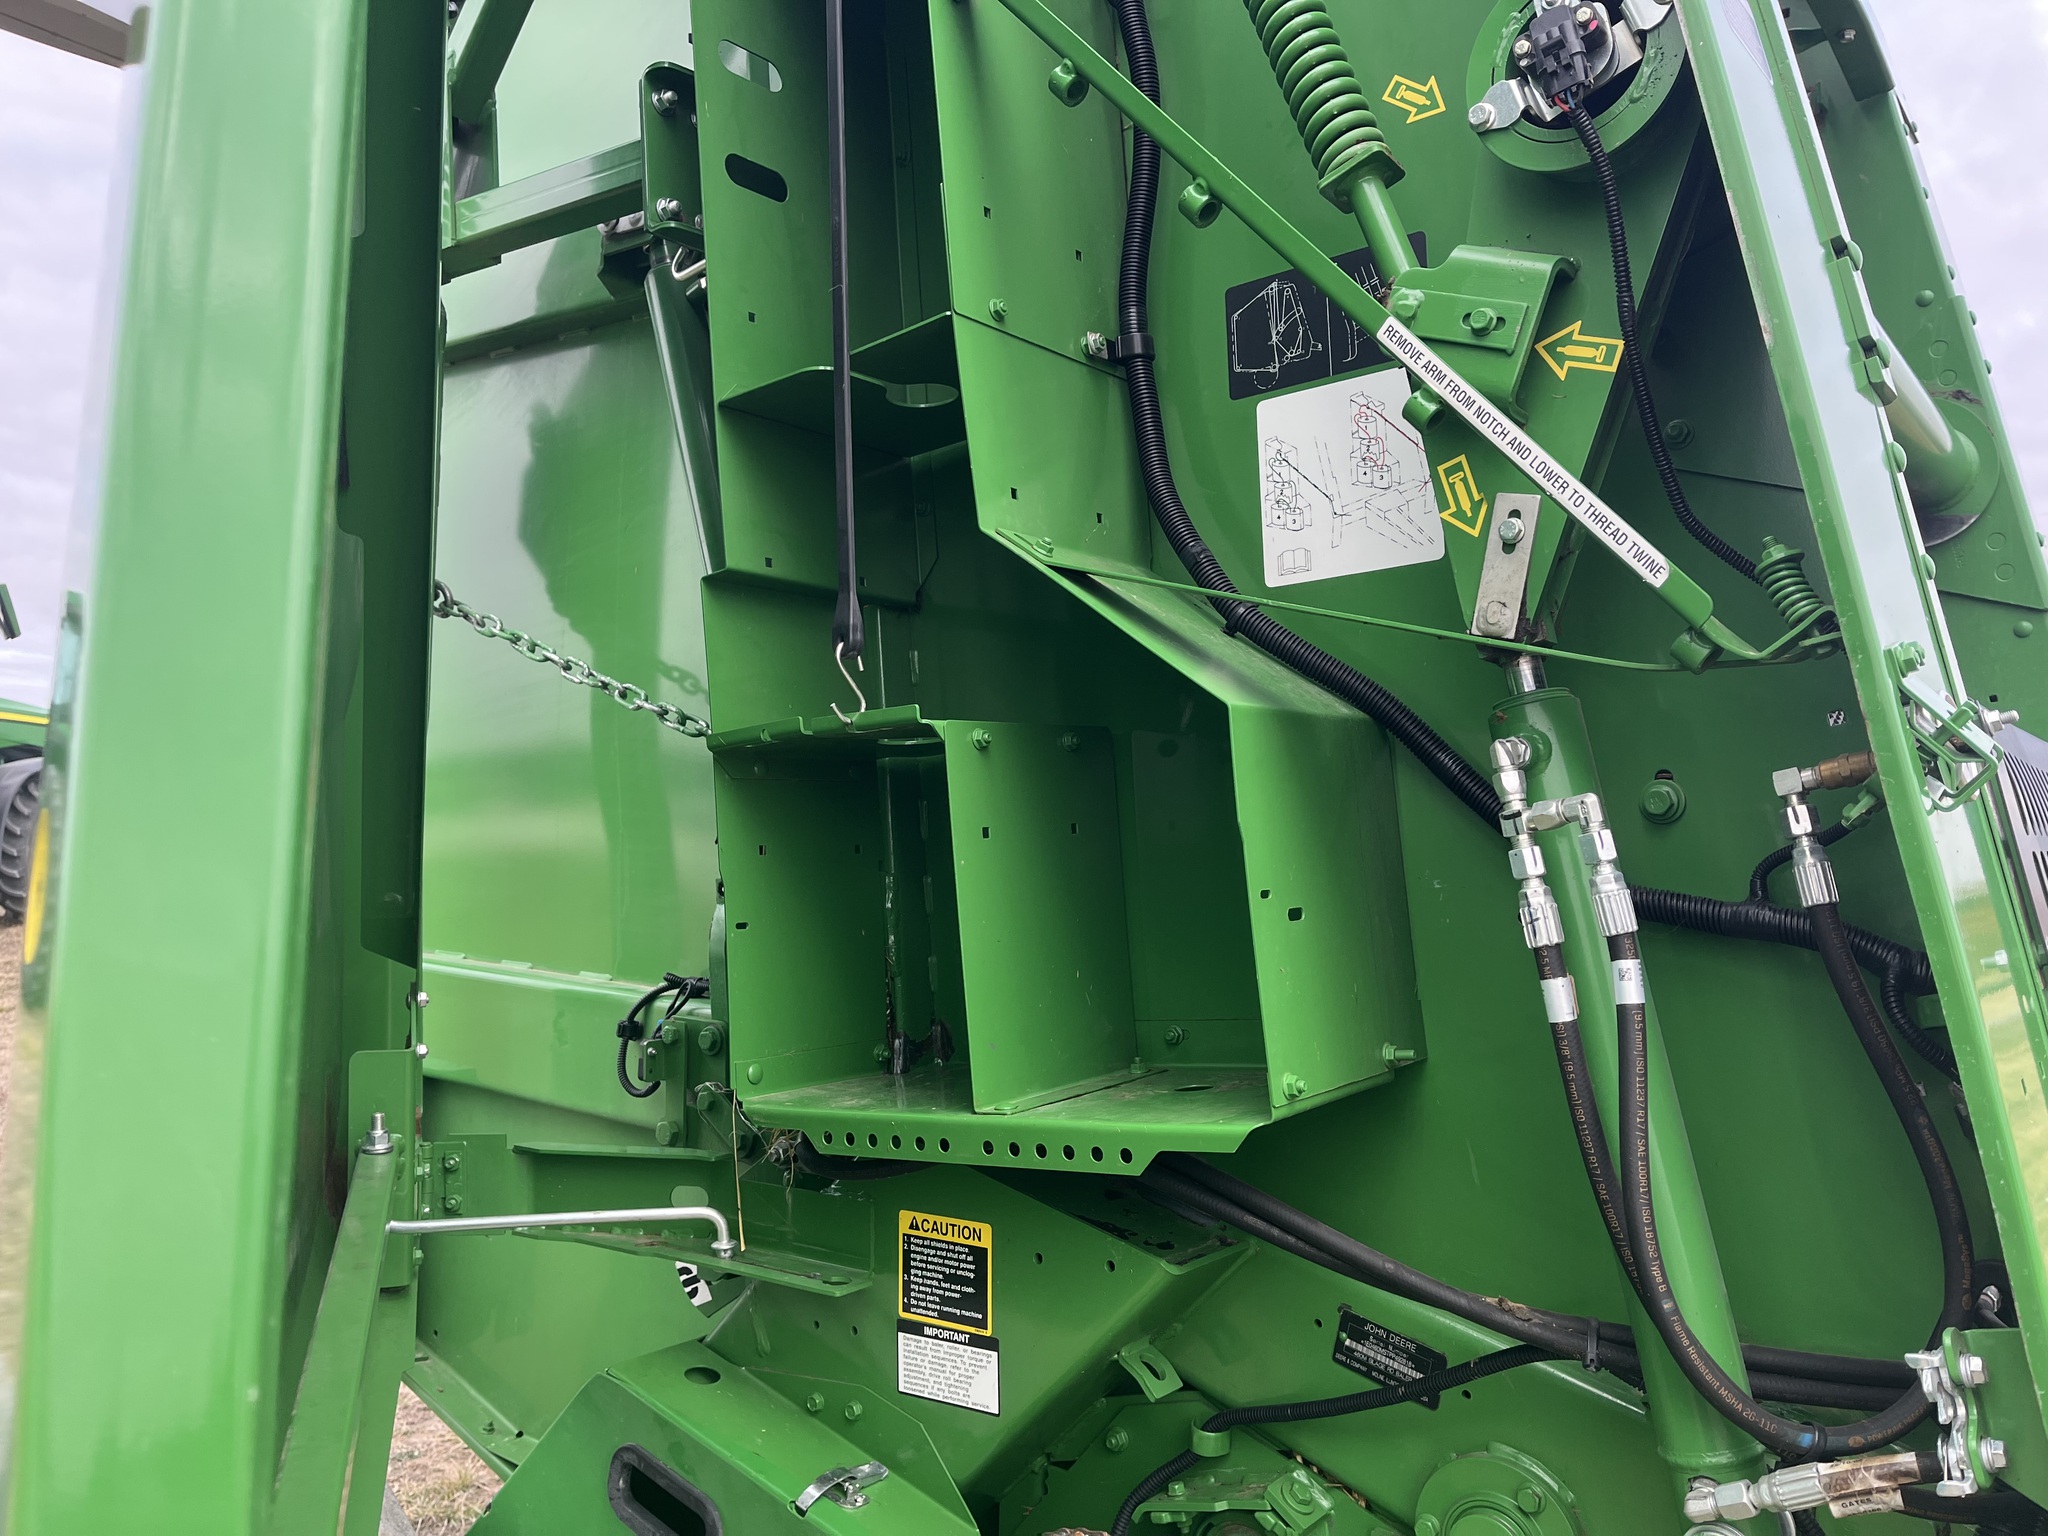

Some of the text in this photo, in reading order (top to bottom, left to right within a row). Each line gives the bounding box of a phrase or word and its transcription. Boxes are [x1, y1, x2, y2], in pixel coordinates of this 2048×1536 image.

[1383, 324, 1666, 579] REMOVE ARM FROM NOTCH AND LOWER TO THREAD TWINE
[1633, 1031, 1645, 1055] mm)
[1636, 1057, 1645, 1074] ISO
[1636, 1076, 1645, 1108] 11237
[1573, 1106, 1586, 1122] ISO
[1636, 1110, 1646, 1129] R17
[1579, 1124, 1595, 1154] 11237
[1637, 1139, 1647, 1158] SAE
[1587, 1156, 1601, 1174] R17
[1596, 1183, 1609, 1201] SAE
[1603, 1203, 1624, 1238] 100R17
[1641, 1206, 1652, 1223] ISO
[921, 1218, 982, 1243] CAUTION
[910, 1236, 923, 1246] Keep
[931, 1240, 949, 1250] shields
[955, 1244, 971, 1253] place.
[1644, 1226, 1659, 1259] 18752
[910, 1244, 936, 1256] Disengage
[937, 1249, 947, 1257] and
[947, 1250, 959, 1259] shut
[959, 1252, 967, 1260] off
[910, 1252, 976, 1270] engine and/or motor power
[1620, 1247, 1634, 1264] ISO
[910, 1260, 926, 1269] before
[927, 1263, 949, 1274] servicing
[956, 1269, 976, 1279] unclog-
[910, 1268, 944, 1280] ging machine.
[1650, 1259, 1664, 1283] Type
[910, 1275, 923, 1284] Keep
[924, 1277, 940, 1287] hands,
[940, 1281, 950, 1289] feet
[961, 1285, 976, 1294] cloth-
[910, 1283, 962, 1299] ing away from power-
[1658, 1285, 1668, 1293] B
[910, 1291, 941, 1303] driven parts.
[910, 1298, 918, 1306] Do
[927, 1301, 940, 1310] leave
[940, 1305, 960, 1316] running
[961, 1309, 983, 1320] machine
[910, 1307, 940, 1318] unattended.
[923, 1325, 970, 1344] IMPORTANT
[1364, 1322, 1417, 1353] JOHN DEERE
[1671, 1315, 1690, 1347] Flame
[902, 1335, 922, 1344] Damage
[970, 1348, 993, 1359] bearings
[903, 1353, 918, 1362] failure
[943, 1350, 965, 1360] improper
[967, 1354, 984, 1364] torque
[960, 1358, 967, 1366] To
[968, 1362, 988, 1371] prevent
[928, 1366, 947, 1374] manual
[958, 1373, 975, 1381] proper
[1686, 1346, 1721, 1390] Resistant
[903, 1379, 929, 1390] sequences
[936, 1387, 946, 1395] any
[947, 1388, 960, 1397] bolts
[928, 1371, 941, 1379] drive
[953, 1377, 972, 1388] bearing
[944, 1381, 969, 1393] tightening
[903, 1385, 926, 1395] loosened
[927, 1390, 940, 1398] while
[942, 1395, 970, 1406] performing
[1718, 1386, 1744, 1413] MSHA
[1743, 1408, 1778, 1434] 2G-11C
[1841, 1496, 1872, 1510] GATES
